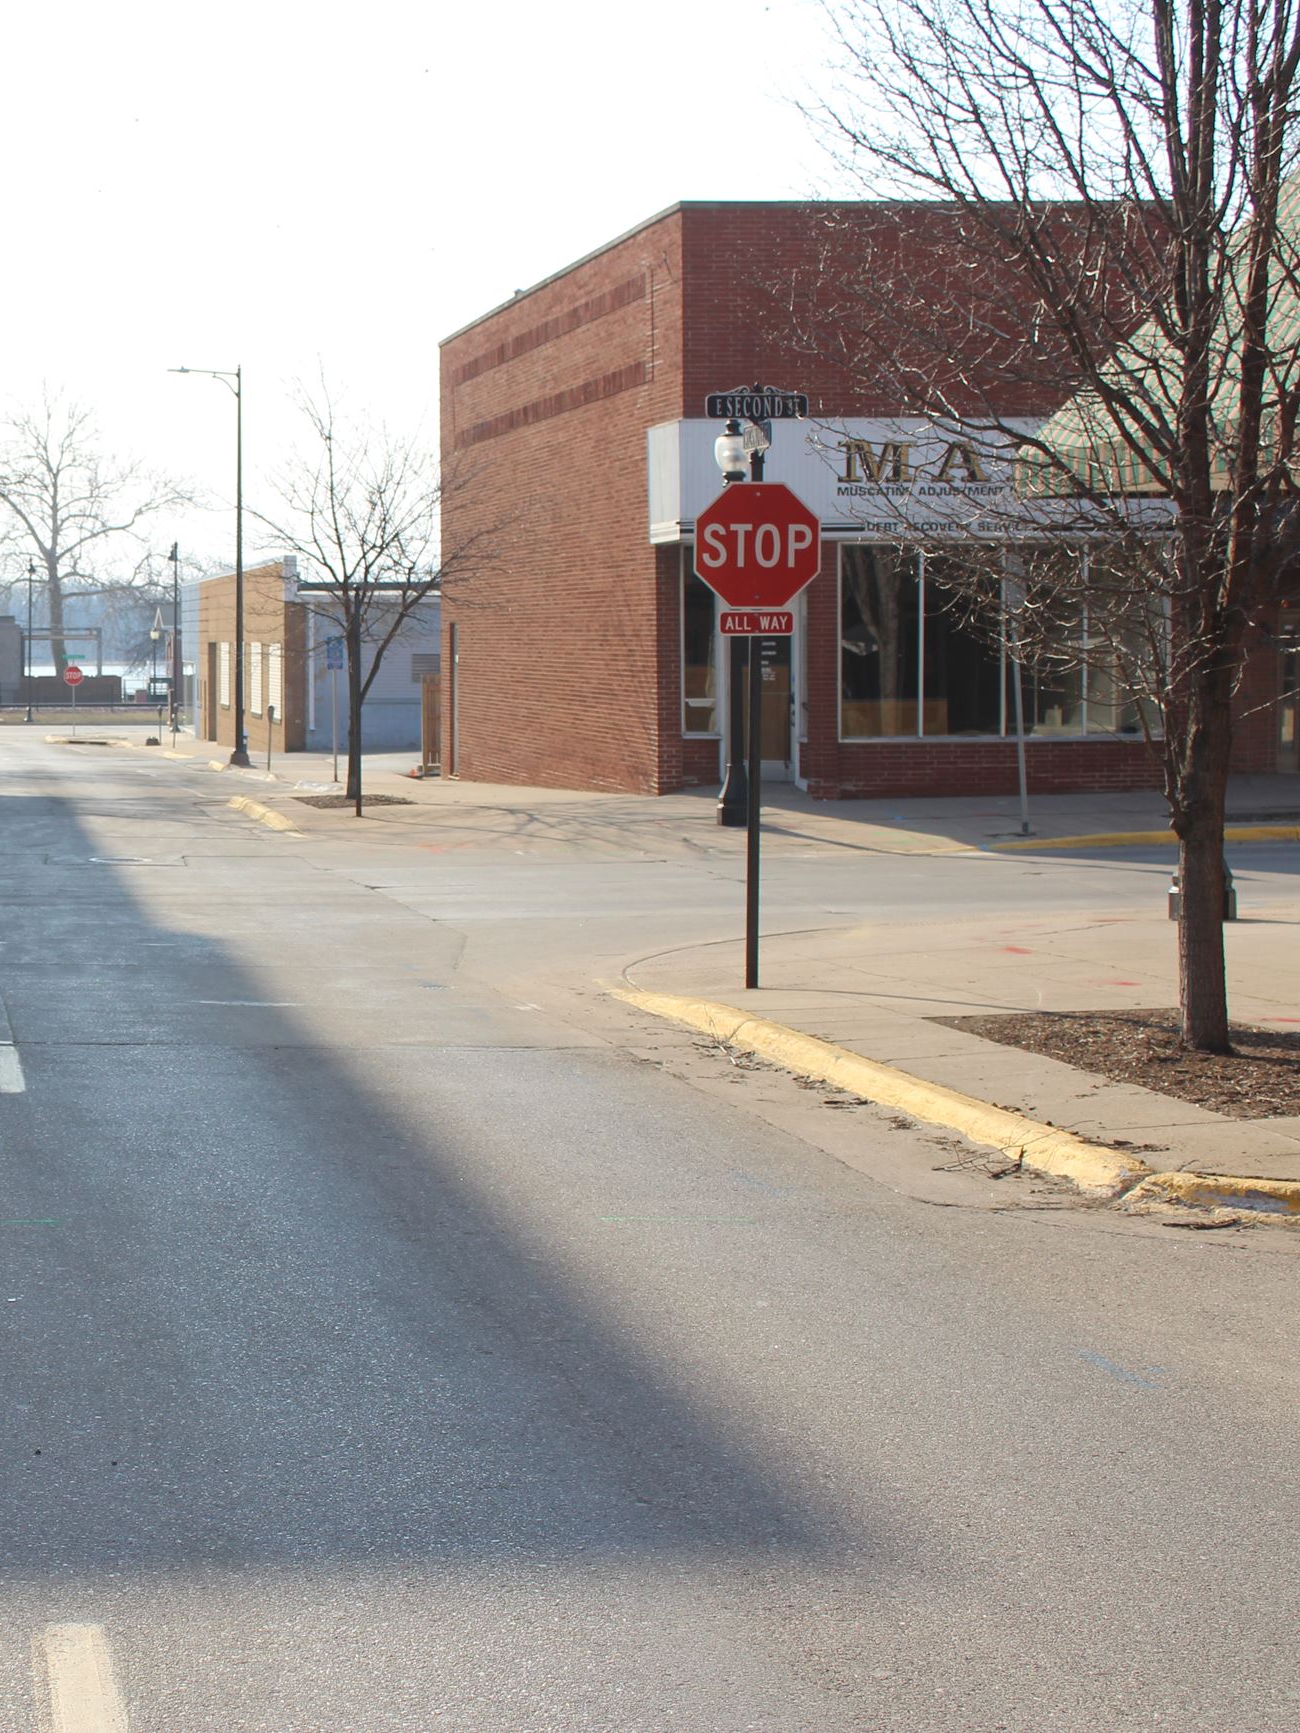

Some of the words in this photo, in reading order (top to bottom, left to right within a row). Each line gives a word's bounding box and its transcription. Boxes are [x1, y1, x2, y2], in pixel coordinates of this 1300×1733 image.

[716, 398, 723, 416] E
[726, 396, 783, 417] SECOND
[702, 523, 813, 568] STOP
[725, 616, 751, 630] ALL
[760, 616, 788, 630] WAY
